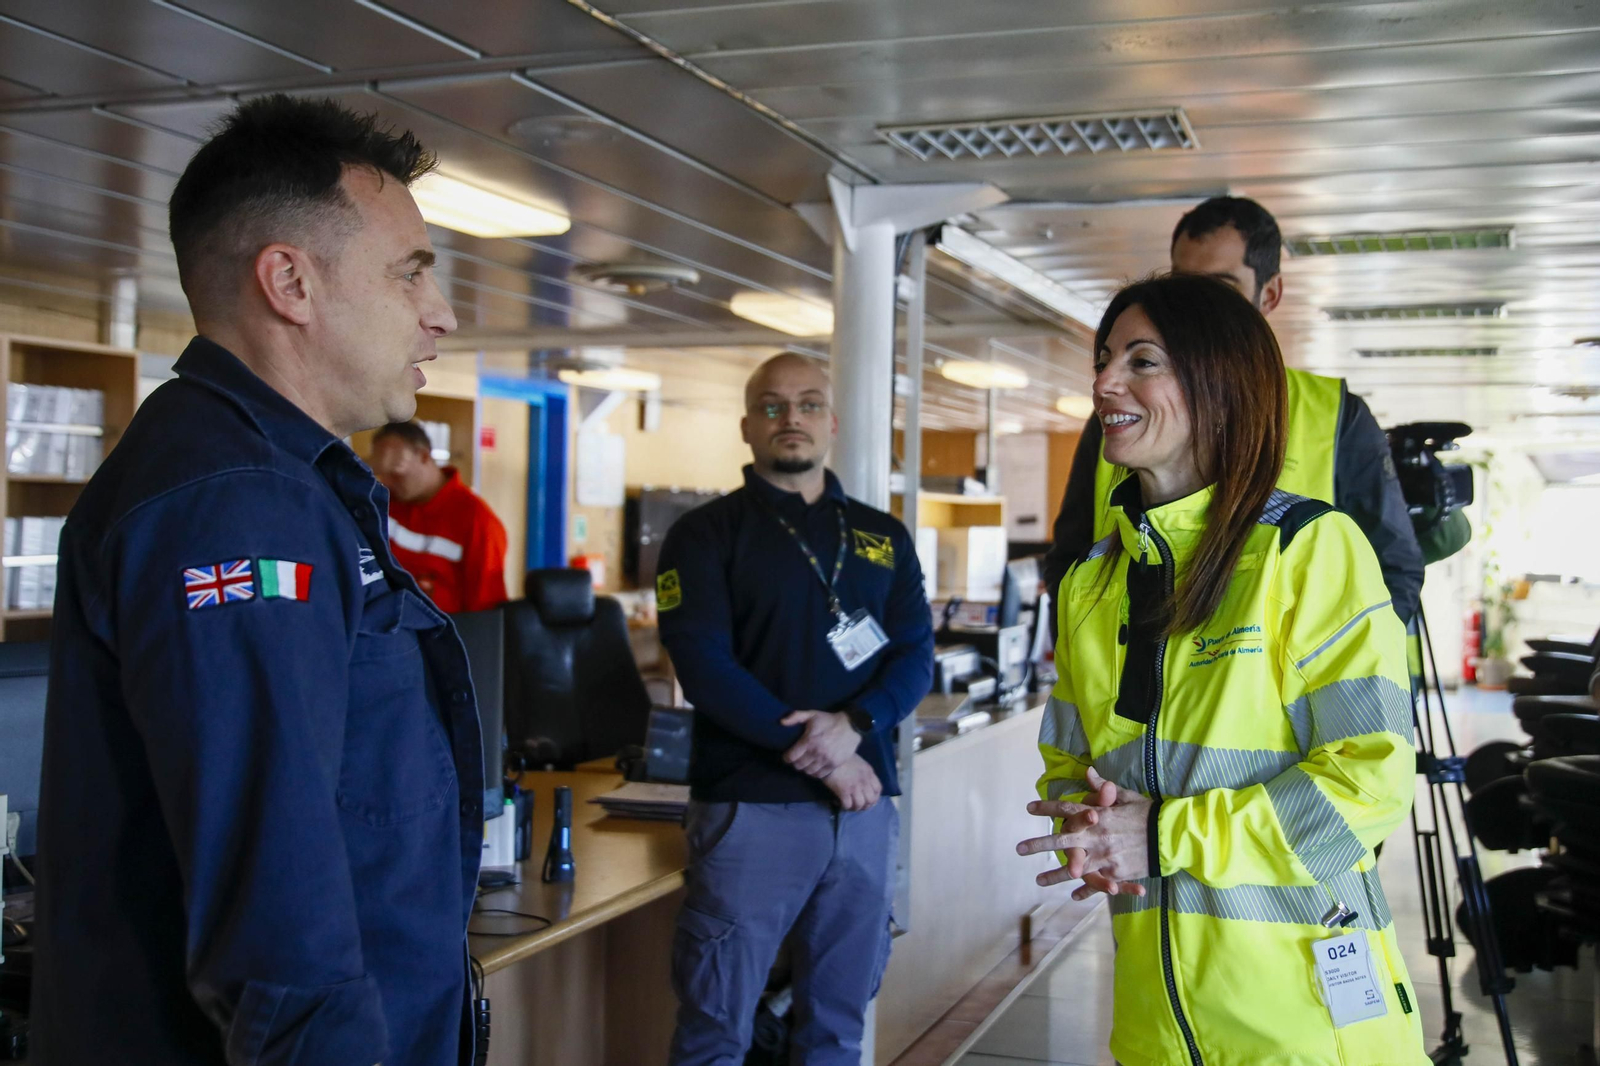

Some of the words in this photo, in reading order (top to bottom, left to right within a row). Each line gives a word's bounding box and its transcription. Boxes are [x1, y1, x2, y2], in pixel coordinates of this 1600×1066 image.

[1231, 624, 1261, 635] Almería
[1327, 942, 1357, 960] 024
[1340, 970, 1357, 979] VISITOR
